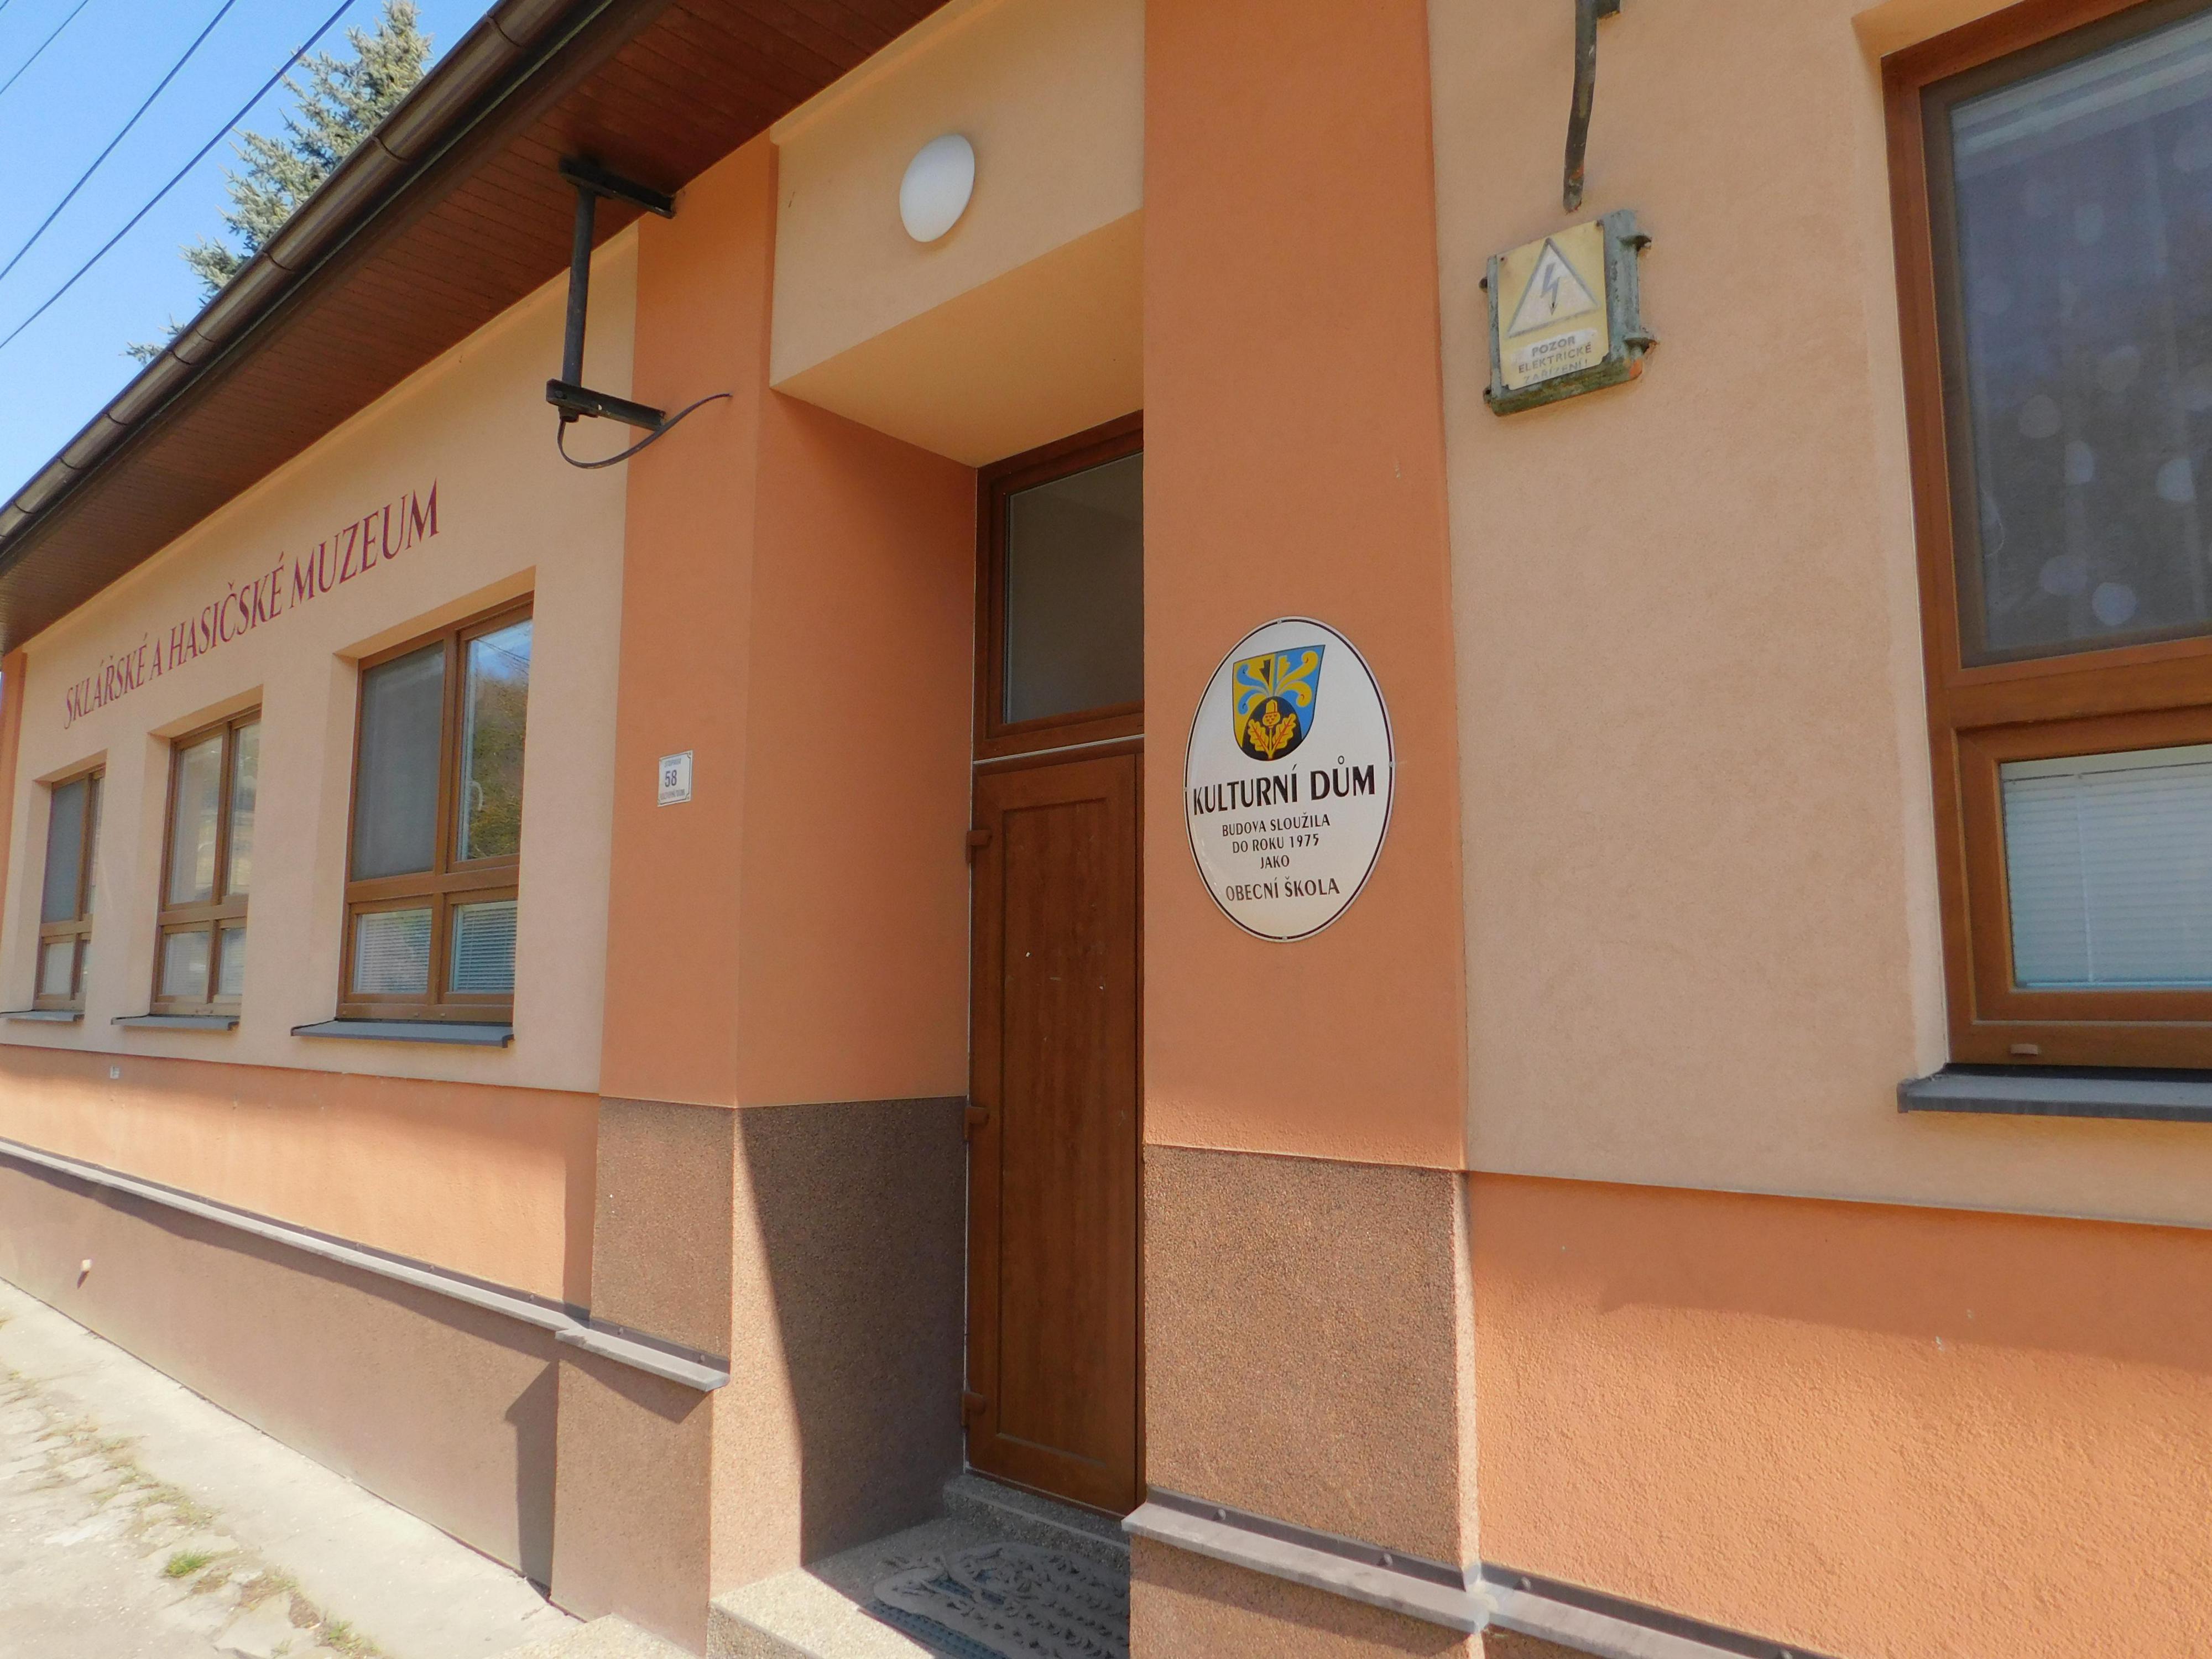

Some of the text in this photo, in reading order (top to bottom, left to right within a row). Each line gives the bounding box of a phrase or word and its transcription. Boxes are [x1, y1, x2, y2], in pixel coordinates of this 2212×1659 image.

[1519, 342, 1592, 374] ELEKTRICKÉ
[1532, 336, 1575, 357] POZOR
[64, 477, 440, 729] SKLÁŘSKÉ A HASIČSKÉ MUZEUM
[665, 769, 677, 787] 58
[1193, 755, 1375, 816] KULTURNÍ DŮM
[1222, 811, 1331, 837] BUDOVA SLOUŽILA
[1232, 833, 1319, 854] DO ROKU 1975
[1260, 855, 1290, 869] JAKO
[1225, 876, 1340, 901] OBECNÍ ŠKOLA
